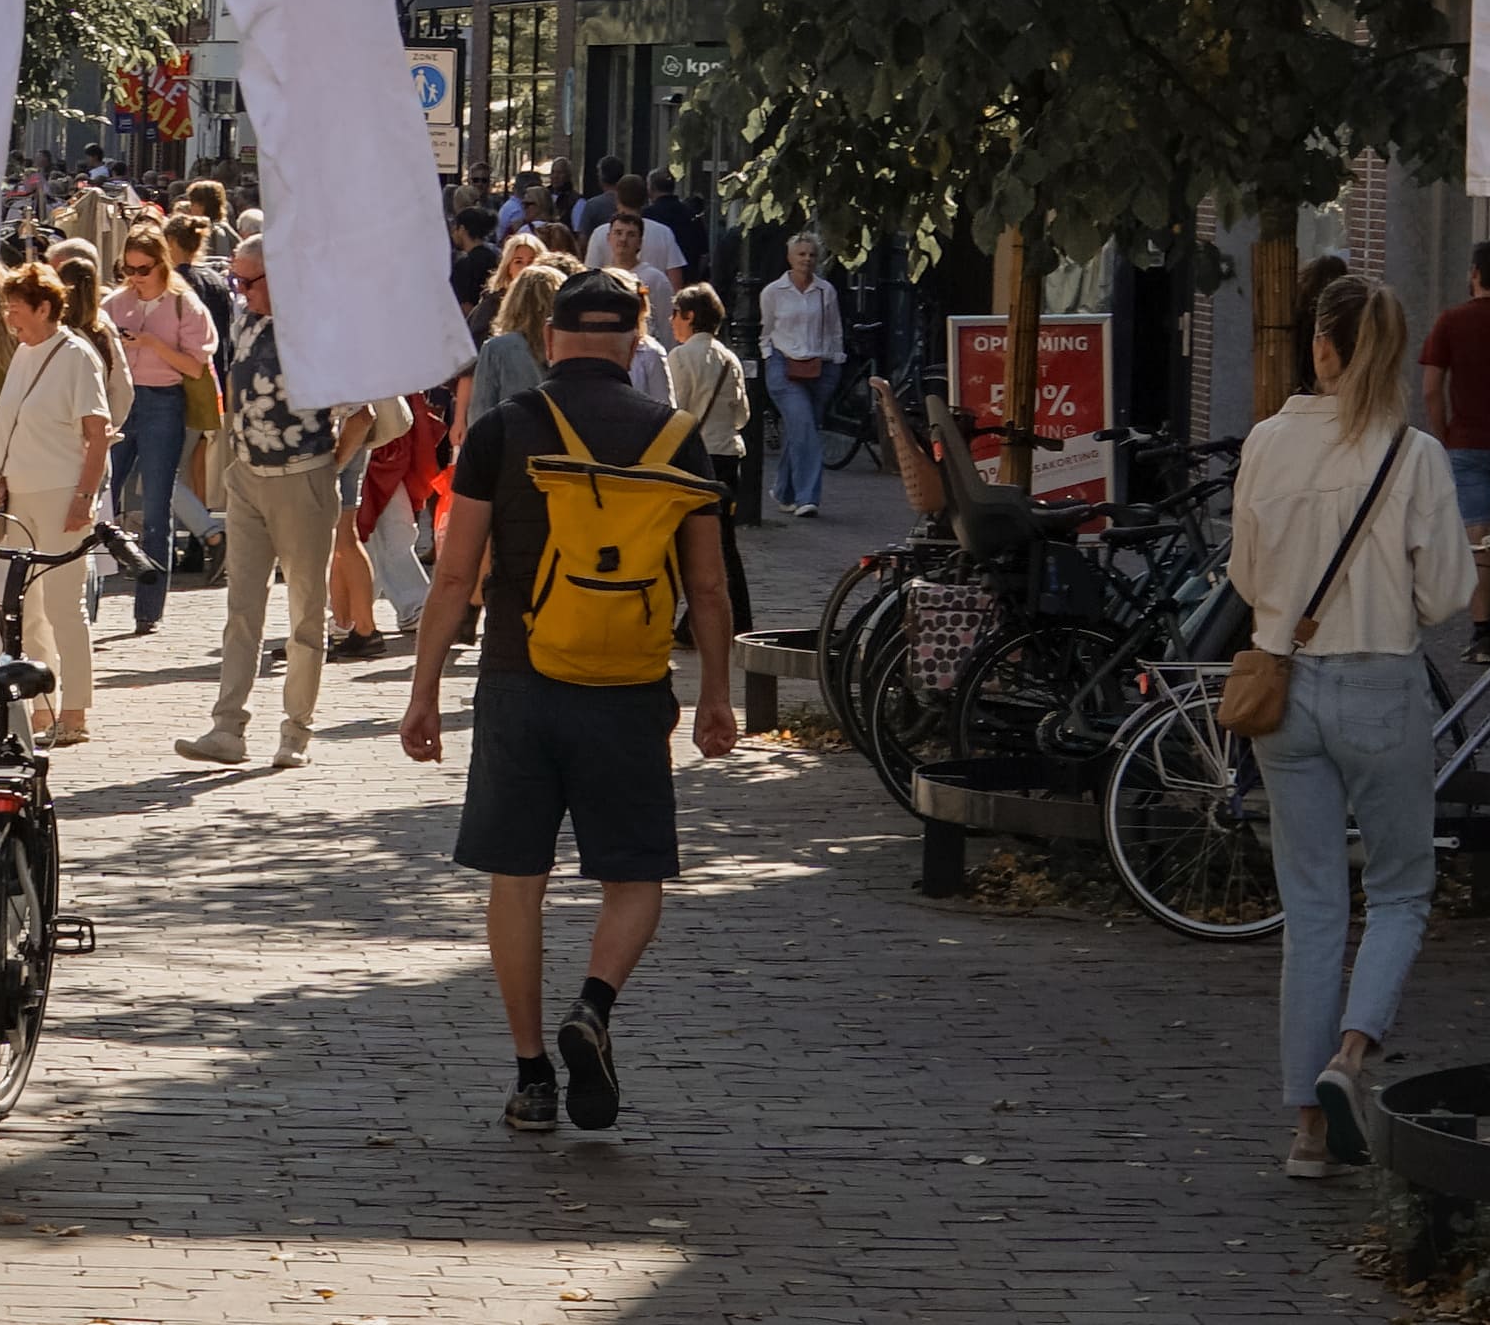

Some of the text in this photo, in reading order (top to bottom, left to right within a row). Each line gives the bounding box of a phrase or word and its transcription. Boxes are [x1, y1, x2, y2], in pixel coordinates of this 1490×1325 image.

[412, 53, 439, 61] ZONE
[973, 335, 1089, 352] OPMING
[989, 384, 1077, 417] 5%
[1032, 449, 1099, 473] SAKORTING
